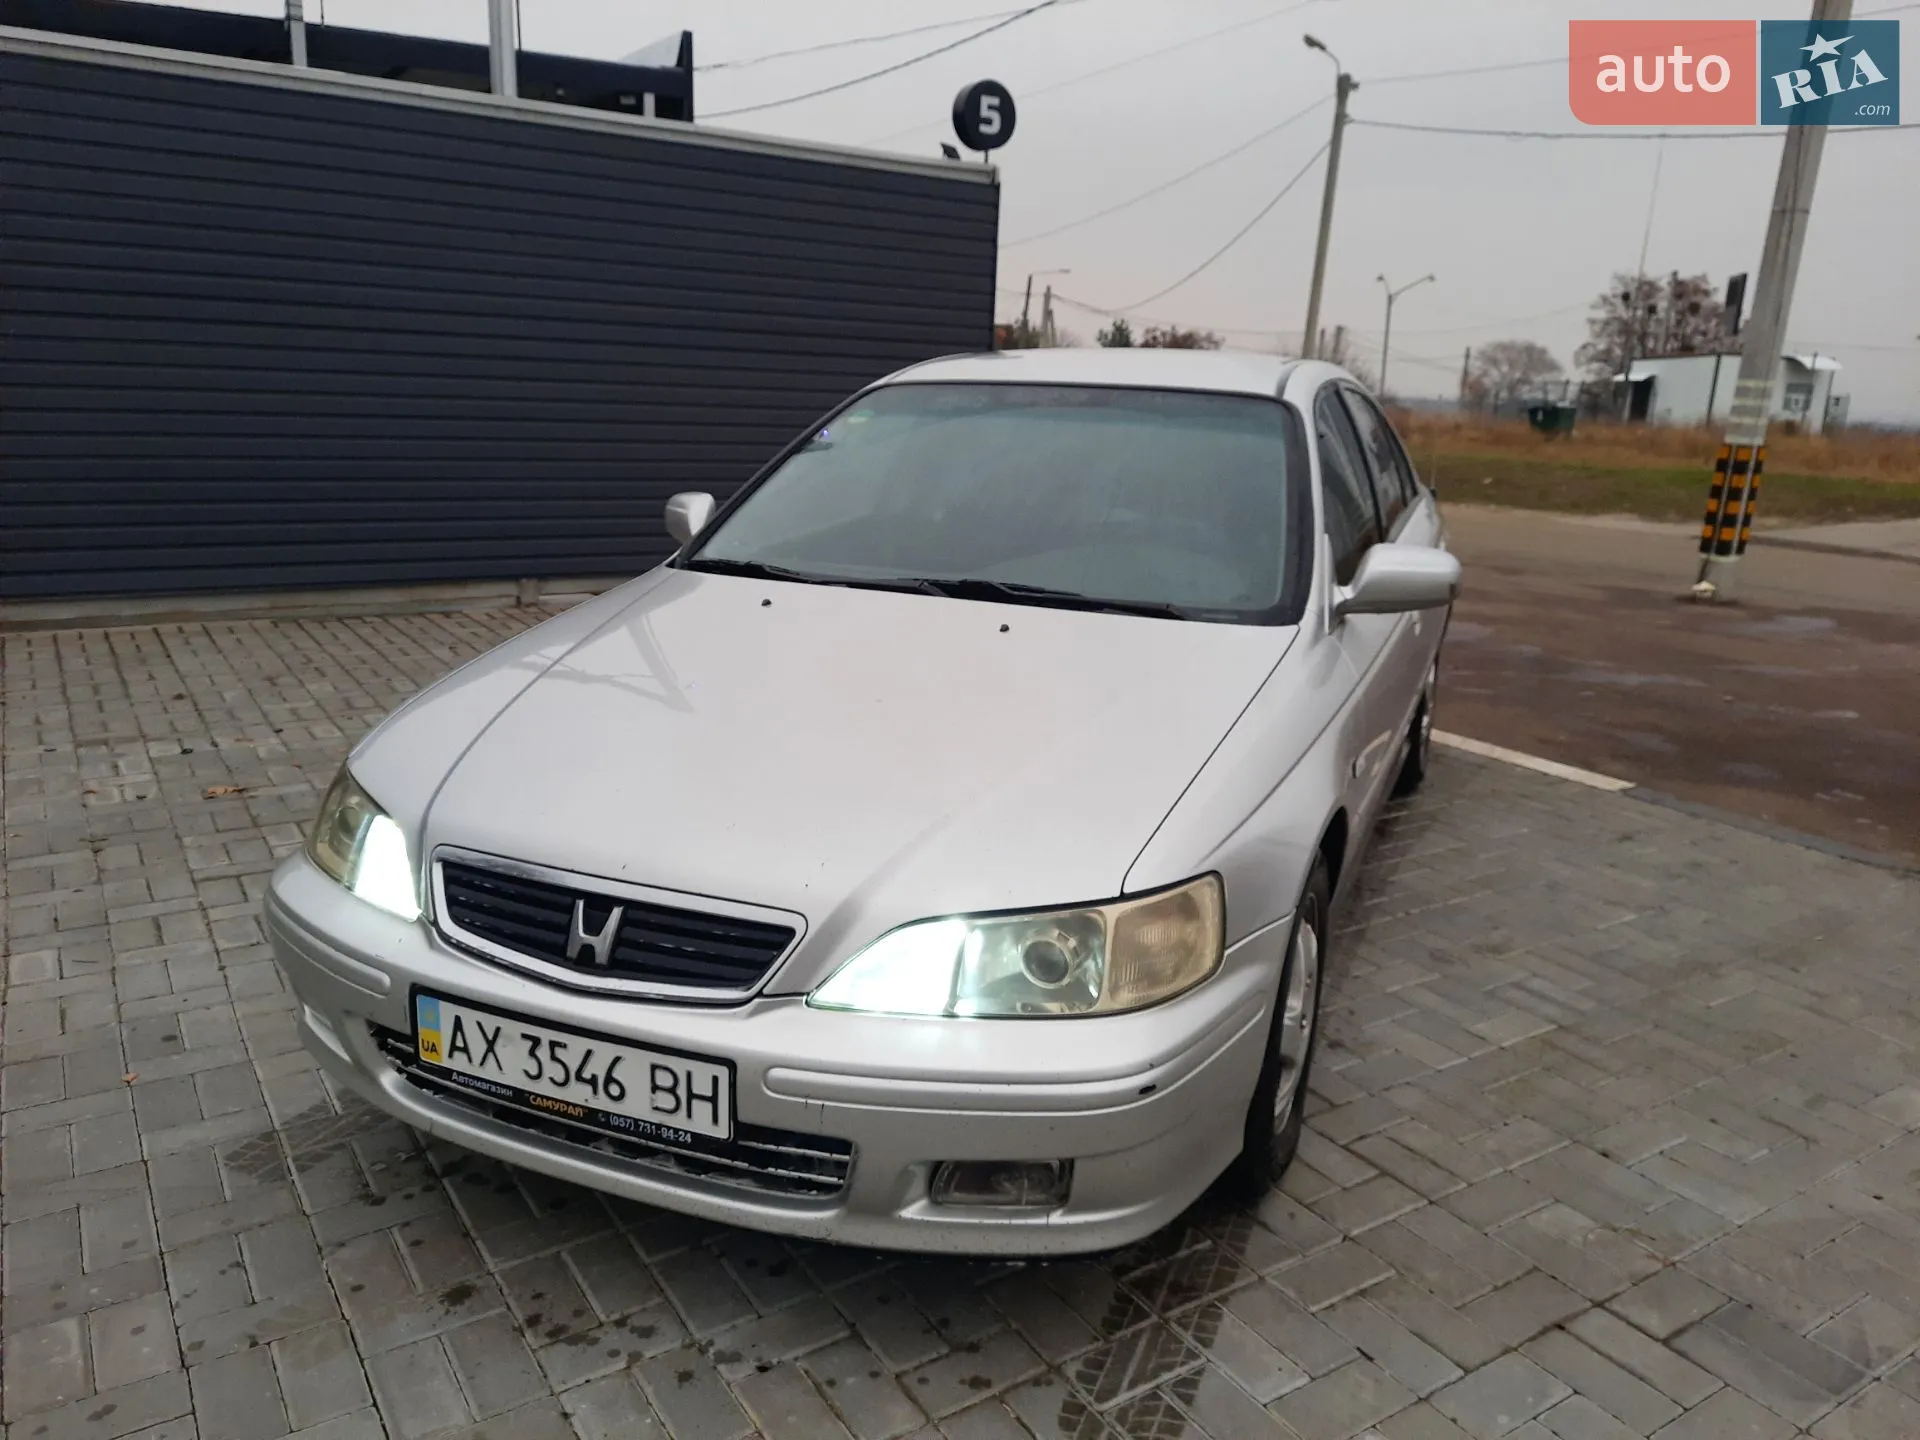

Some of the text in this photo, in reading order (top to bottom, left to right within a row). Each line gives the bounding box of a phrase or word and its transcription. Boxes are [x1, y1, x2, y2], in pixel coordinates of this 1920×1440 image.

[978, 94, 1002, 135] 5
[421, 1038, 440, 1056] UA
[520, 1033, 626, 1101] 3546
[451, 1071, 513, 1097] Автомагазин
[609, 1113, 635, 1131] (057)
